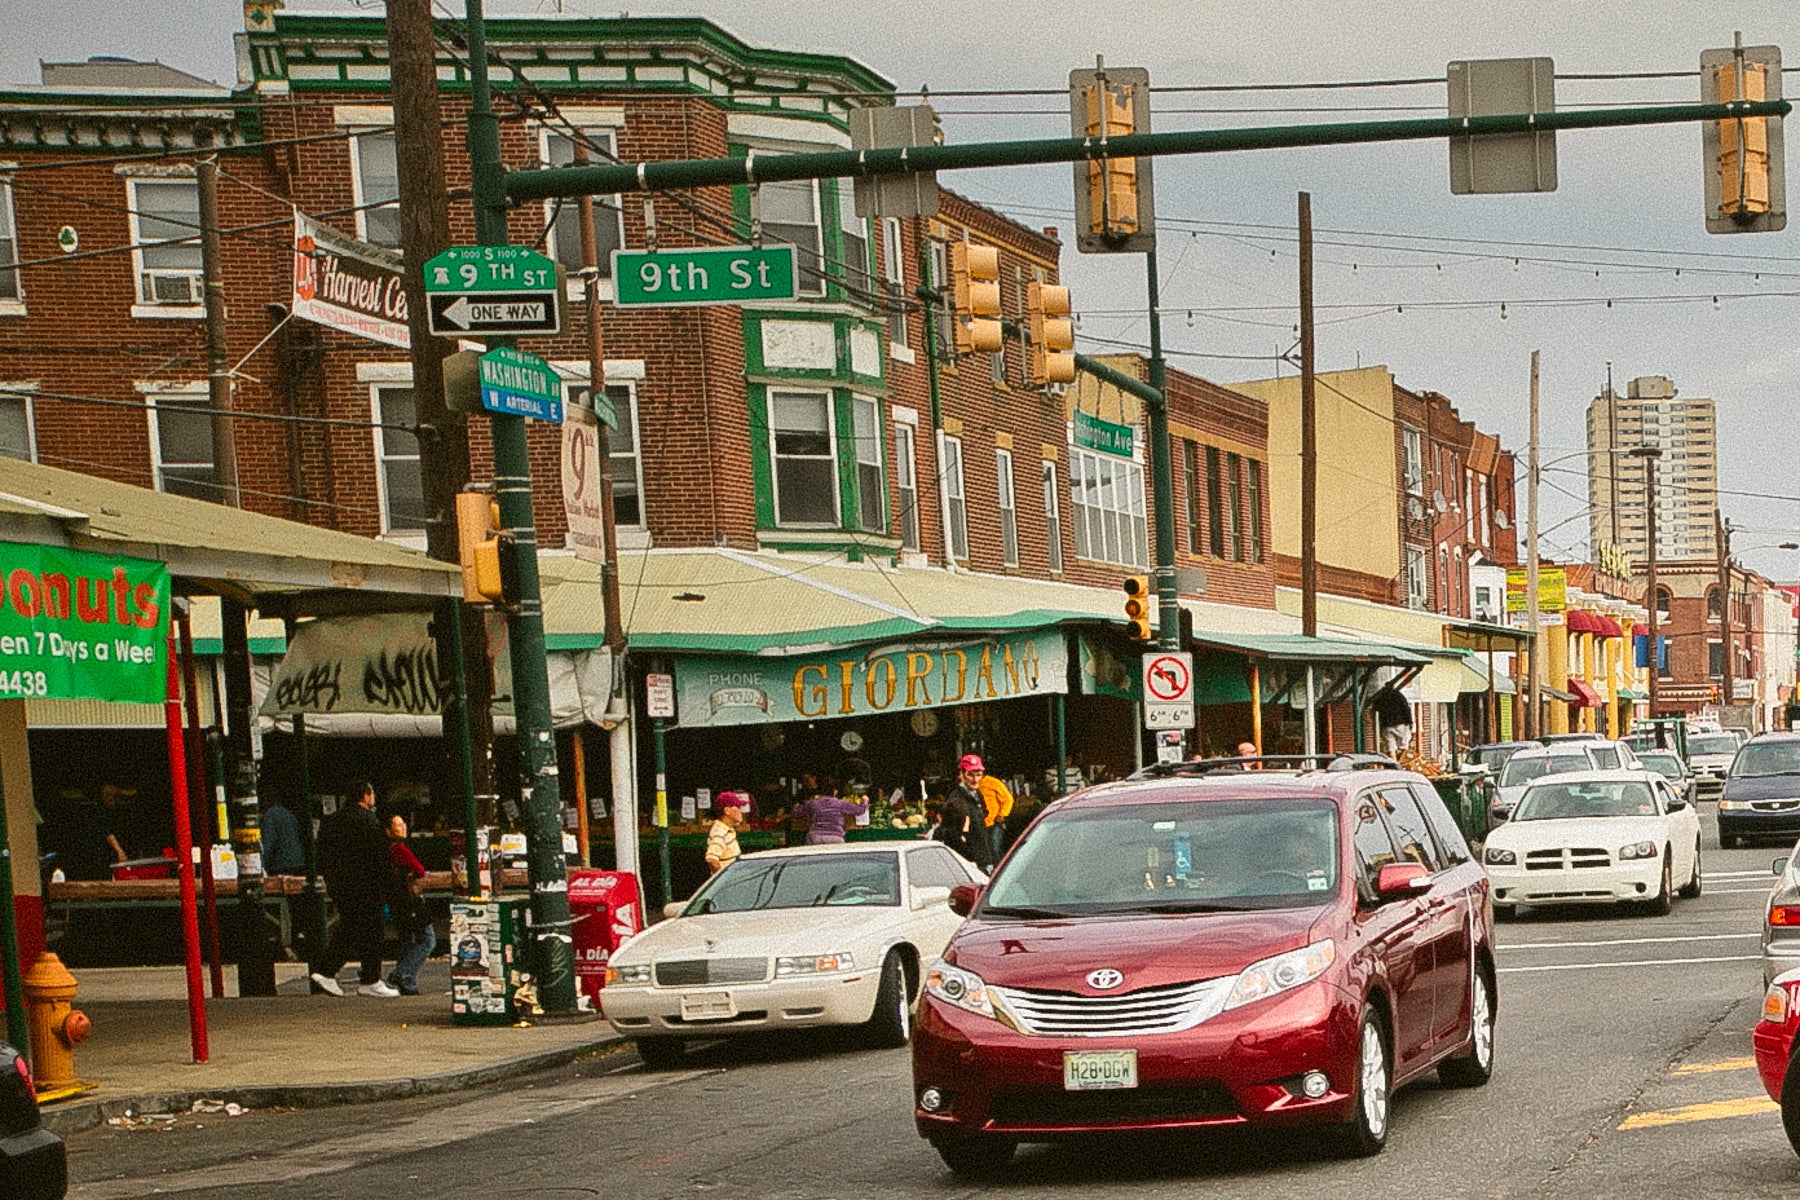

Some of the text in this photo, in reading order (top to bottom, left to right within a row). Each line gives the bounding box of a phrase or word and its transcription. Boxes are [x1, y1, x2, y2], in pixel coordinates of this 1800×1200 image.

[484, 248, 494, 260] S
[322, 255, 382, 313] Harvest
[523, 270, 547, 287] ST
[640, 259, 771, 292] 9th St
[471, 305, 540, 320] ONE WAY
[482, 360, 547, 395] WASHINGTON
[506, 396, 543, 415] ARTERIAL
[0, 566, 160, 630] onuts
[34, 632, 45, 655] 7
[94, 642, 109, 661] a
[709, 673, 763, 686] PHONE
[791, 640, 1040, 717] GIORDANO
